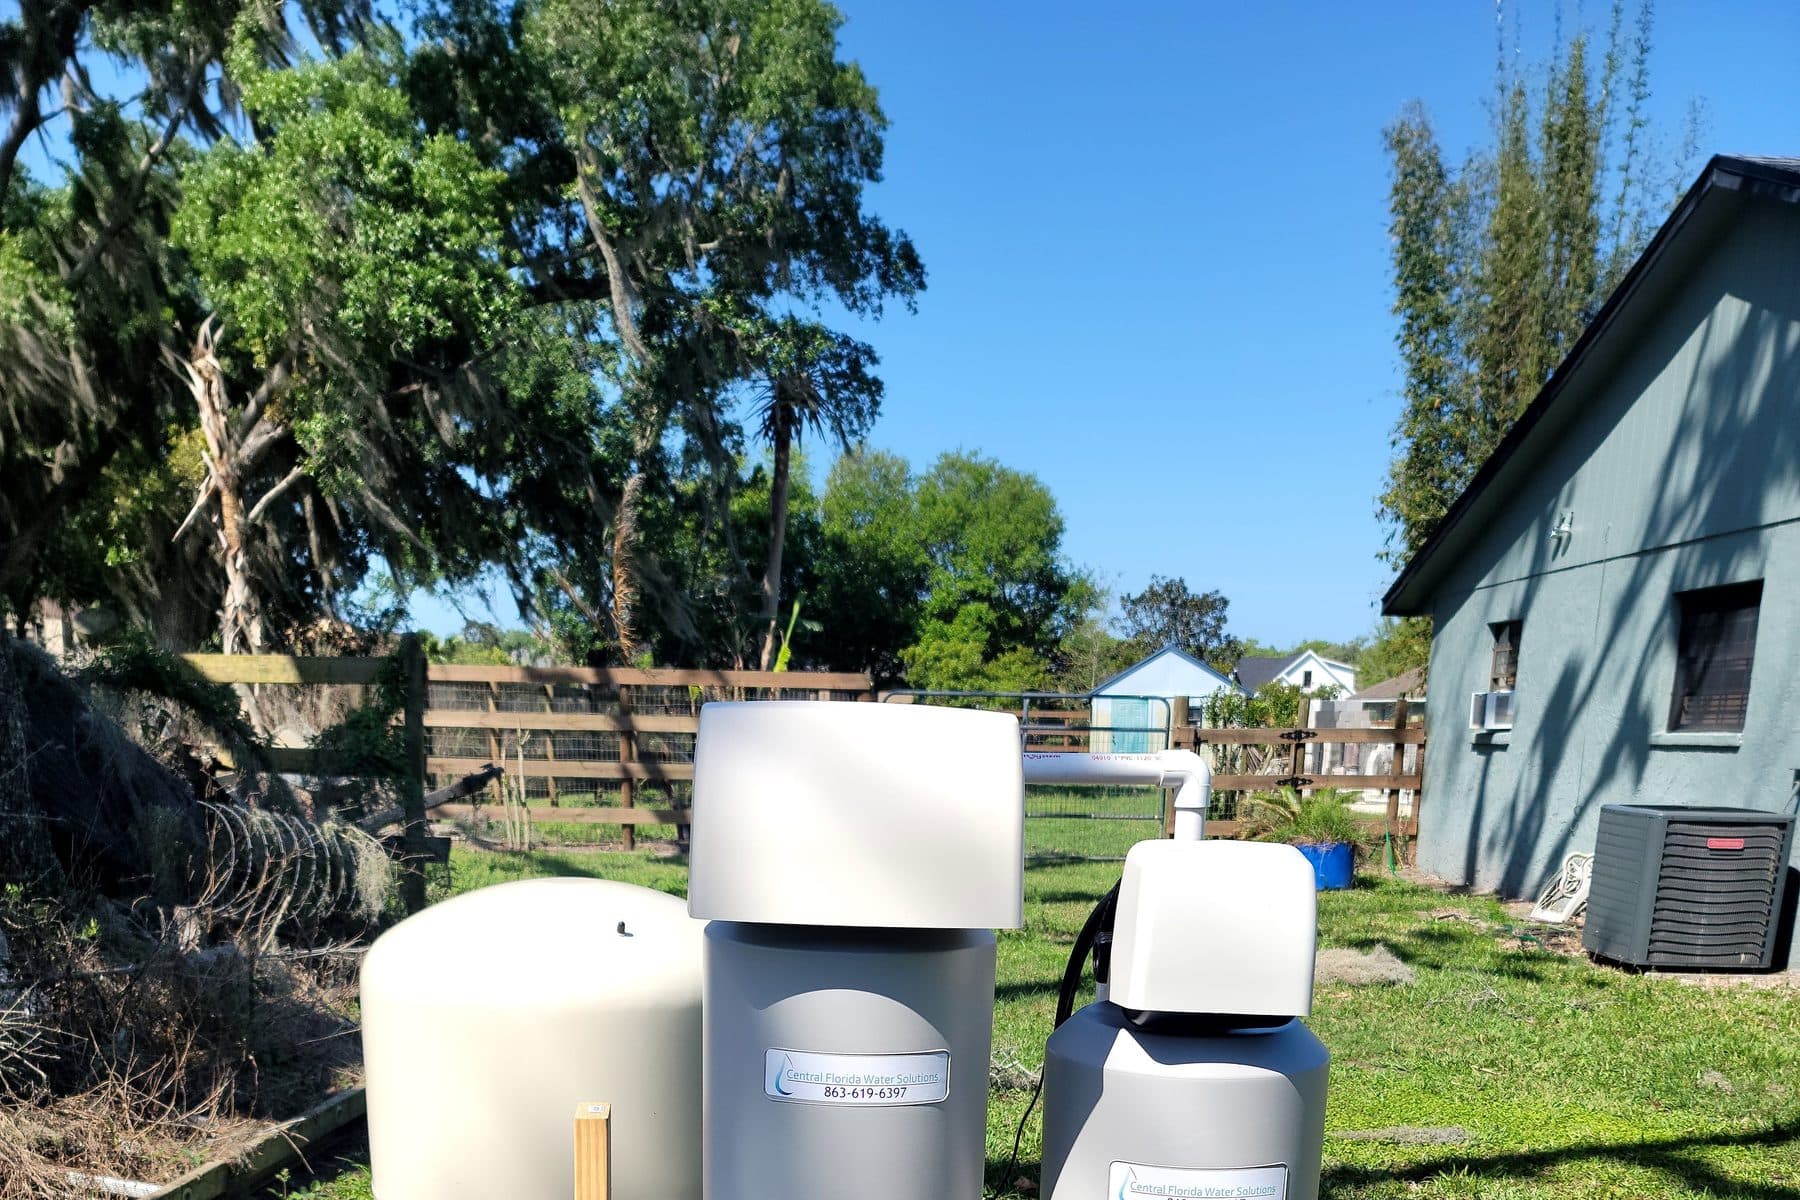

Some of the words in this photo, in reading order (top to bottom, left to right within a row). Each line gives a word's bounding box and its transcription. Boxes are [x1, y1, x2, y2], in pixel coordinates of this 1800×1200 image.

[786, 1068, 823, 1082] Central
[825, 1073, 861, 1084] Florida
[863, 1074, 894, 1084] Water
[896, 1072, 939, 1084] Solutions
[824, 1086, 907, 1099] 863-619-6397
[1130, 1181, 1166, 1194] Central
[1168, 1185, 1203, 1196] Florida
[1204, 1187, 1235, 1197] Water
[1236, 1184, 1276, 1196] Solutions
